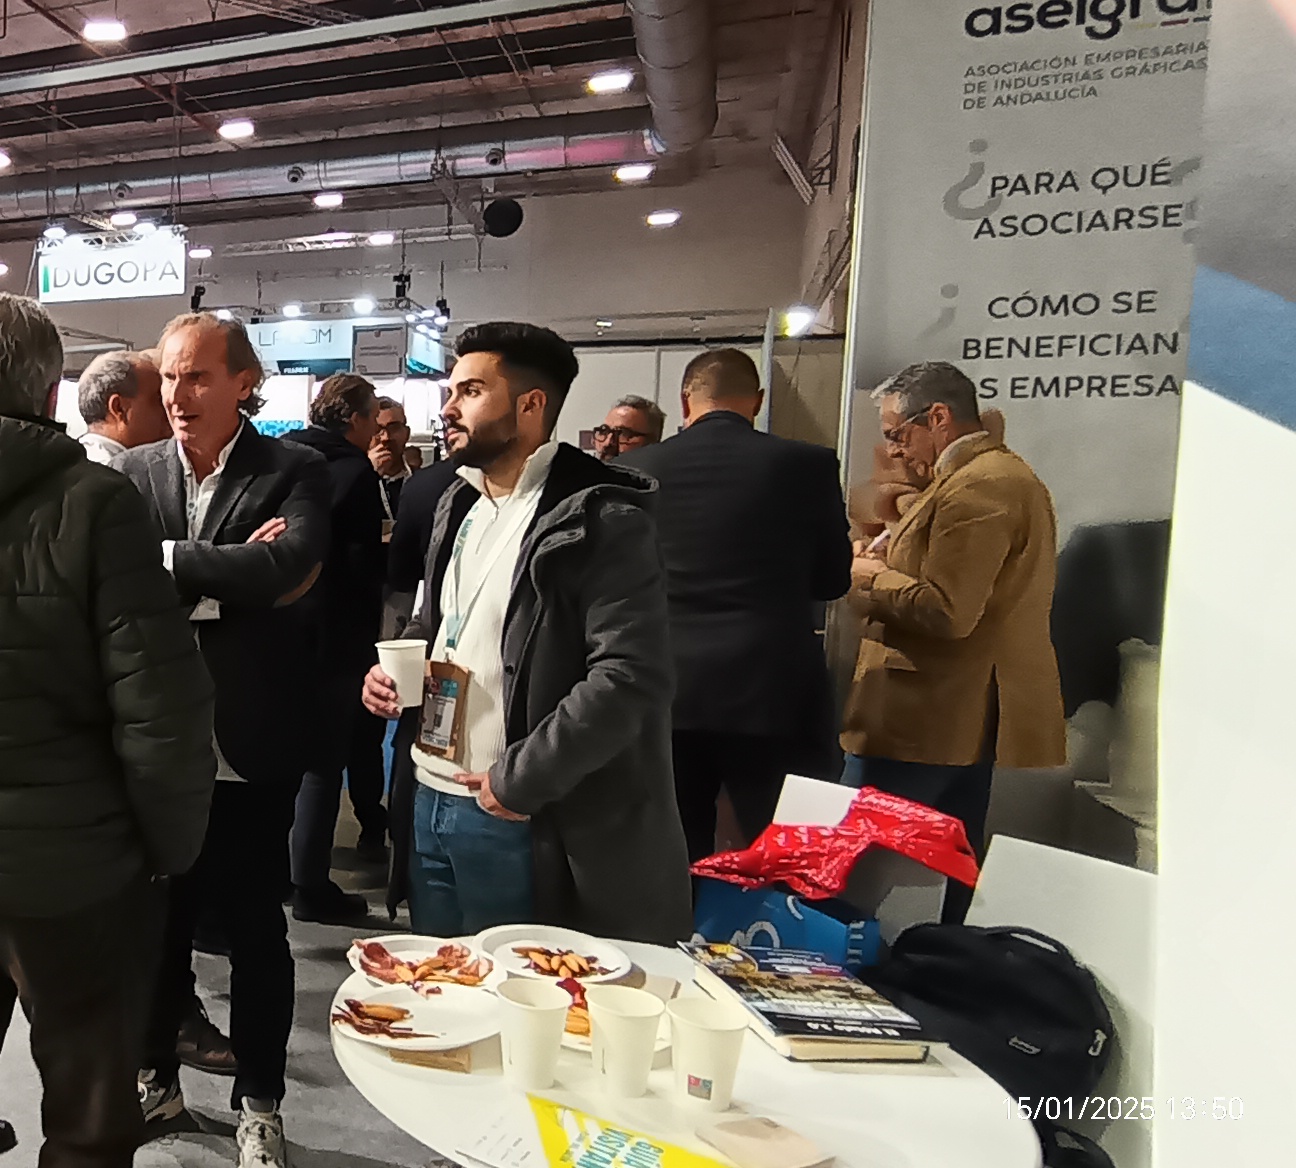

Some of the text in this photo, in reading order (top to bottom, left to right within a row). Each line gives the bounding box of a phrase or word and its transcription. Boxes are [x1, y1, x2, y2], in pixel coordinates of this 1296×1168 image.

[964, 0, 1211, 40] aseigr
[964, 40, 1210, 78] ASOCIACIÓN EMPRESARIA
[963, 57, 1209, 94] DE INDUSTRIAS GRÁFICAS
[963, 85, 1098, 110] DE ANDALUCÍA
[990, 170, 1079, 198] PARA
[1091, 156, 1172, 195] QUÉ
[973, 203, 1183, 239] ASOCIARSE
[54, 260, 179, 288] DUGOPA
[988, 290, 1158, 319] CÓMO SE
[962, 331, 1179, 360] BENEFICIAN
[1010, 374, 1182, 399] EMPRESA
